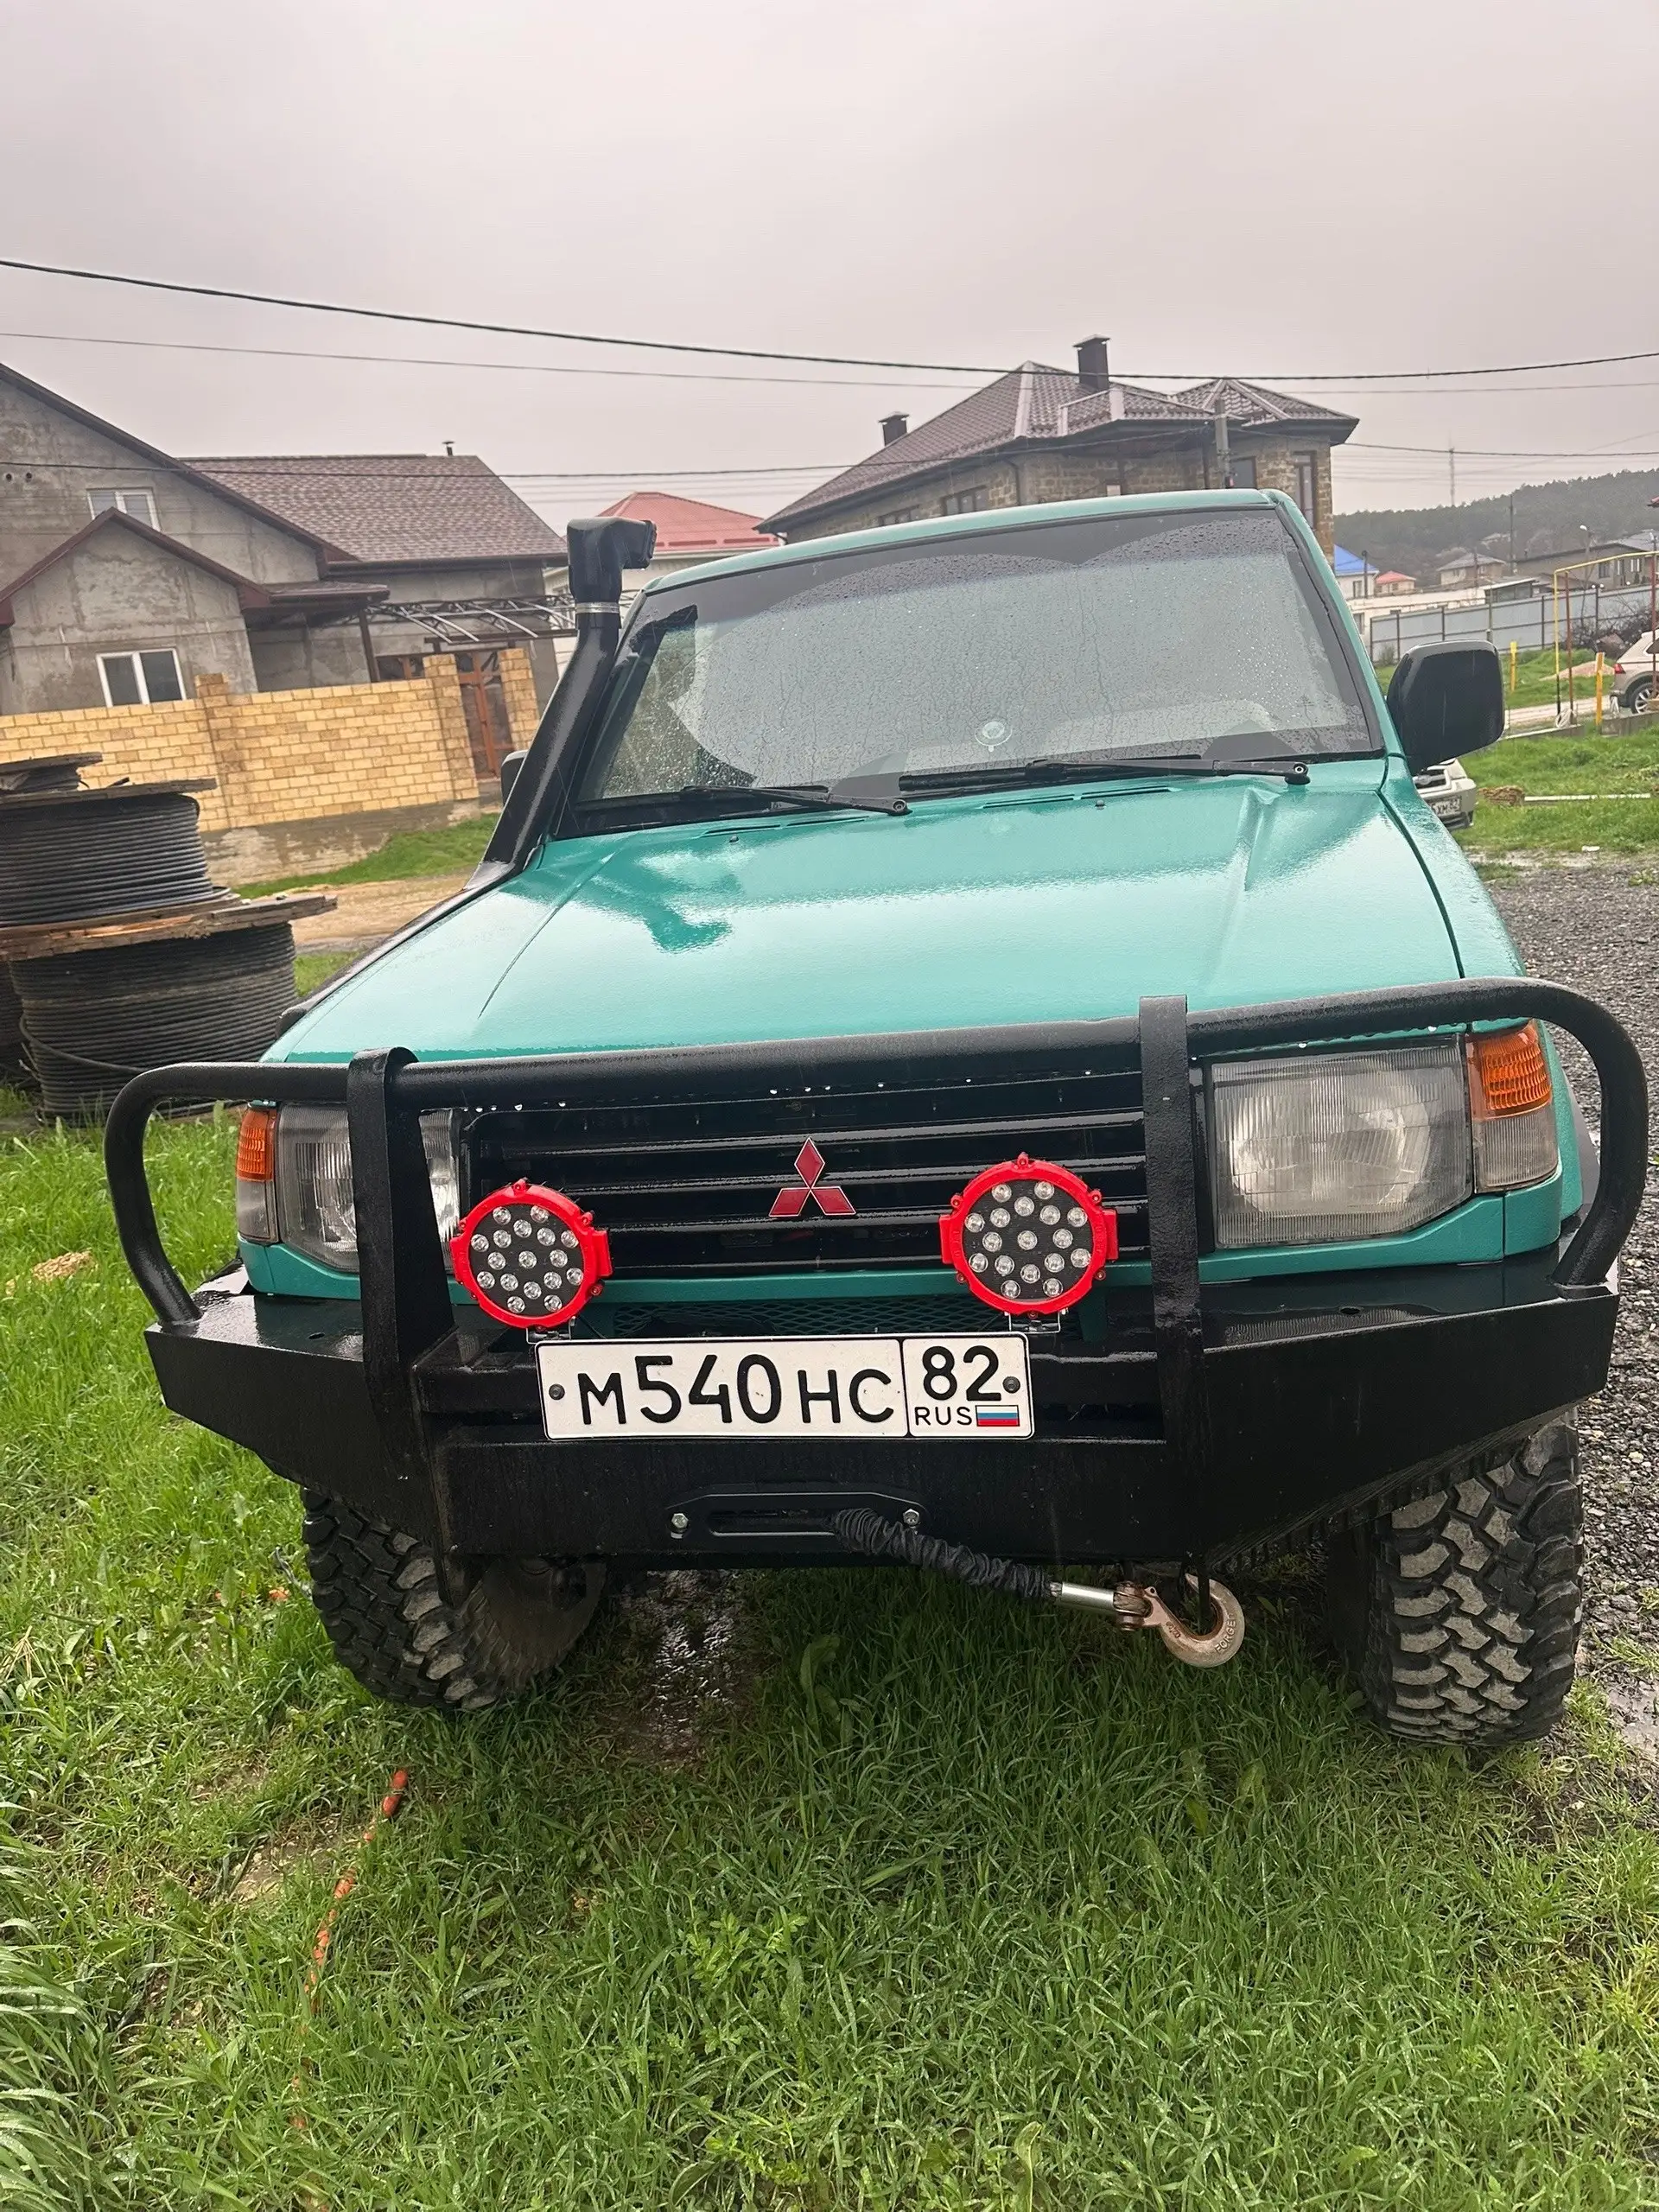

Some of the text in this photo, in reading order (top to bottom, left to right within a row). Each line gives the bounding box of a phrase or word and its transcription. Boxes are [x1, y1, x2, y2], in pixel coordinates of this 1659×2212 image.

[577, 1345, 1002, 1426] М540НС 82
[914, 1405, 973, 1427] RUS
